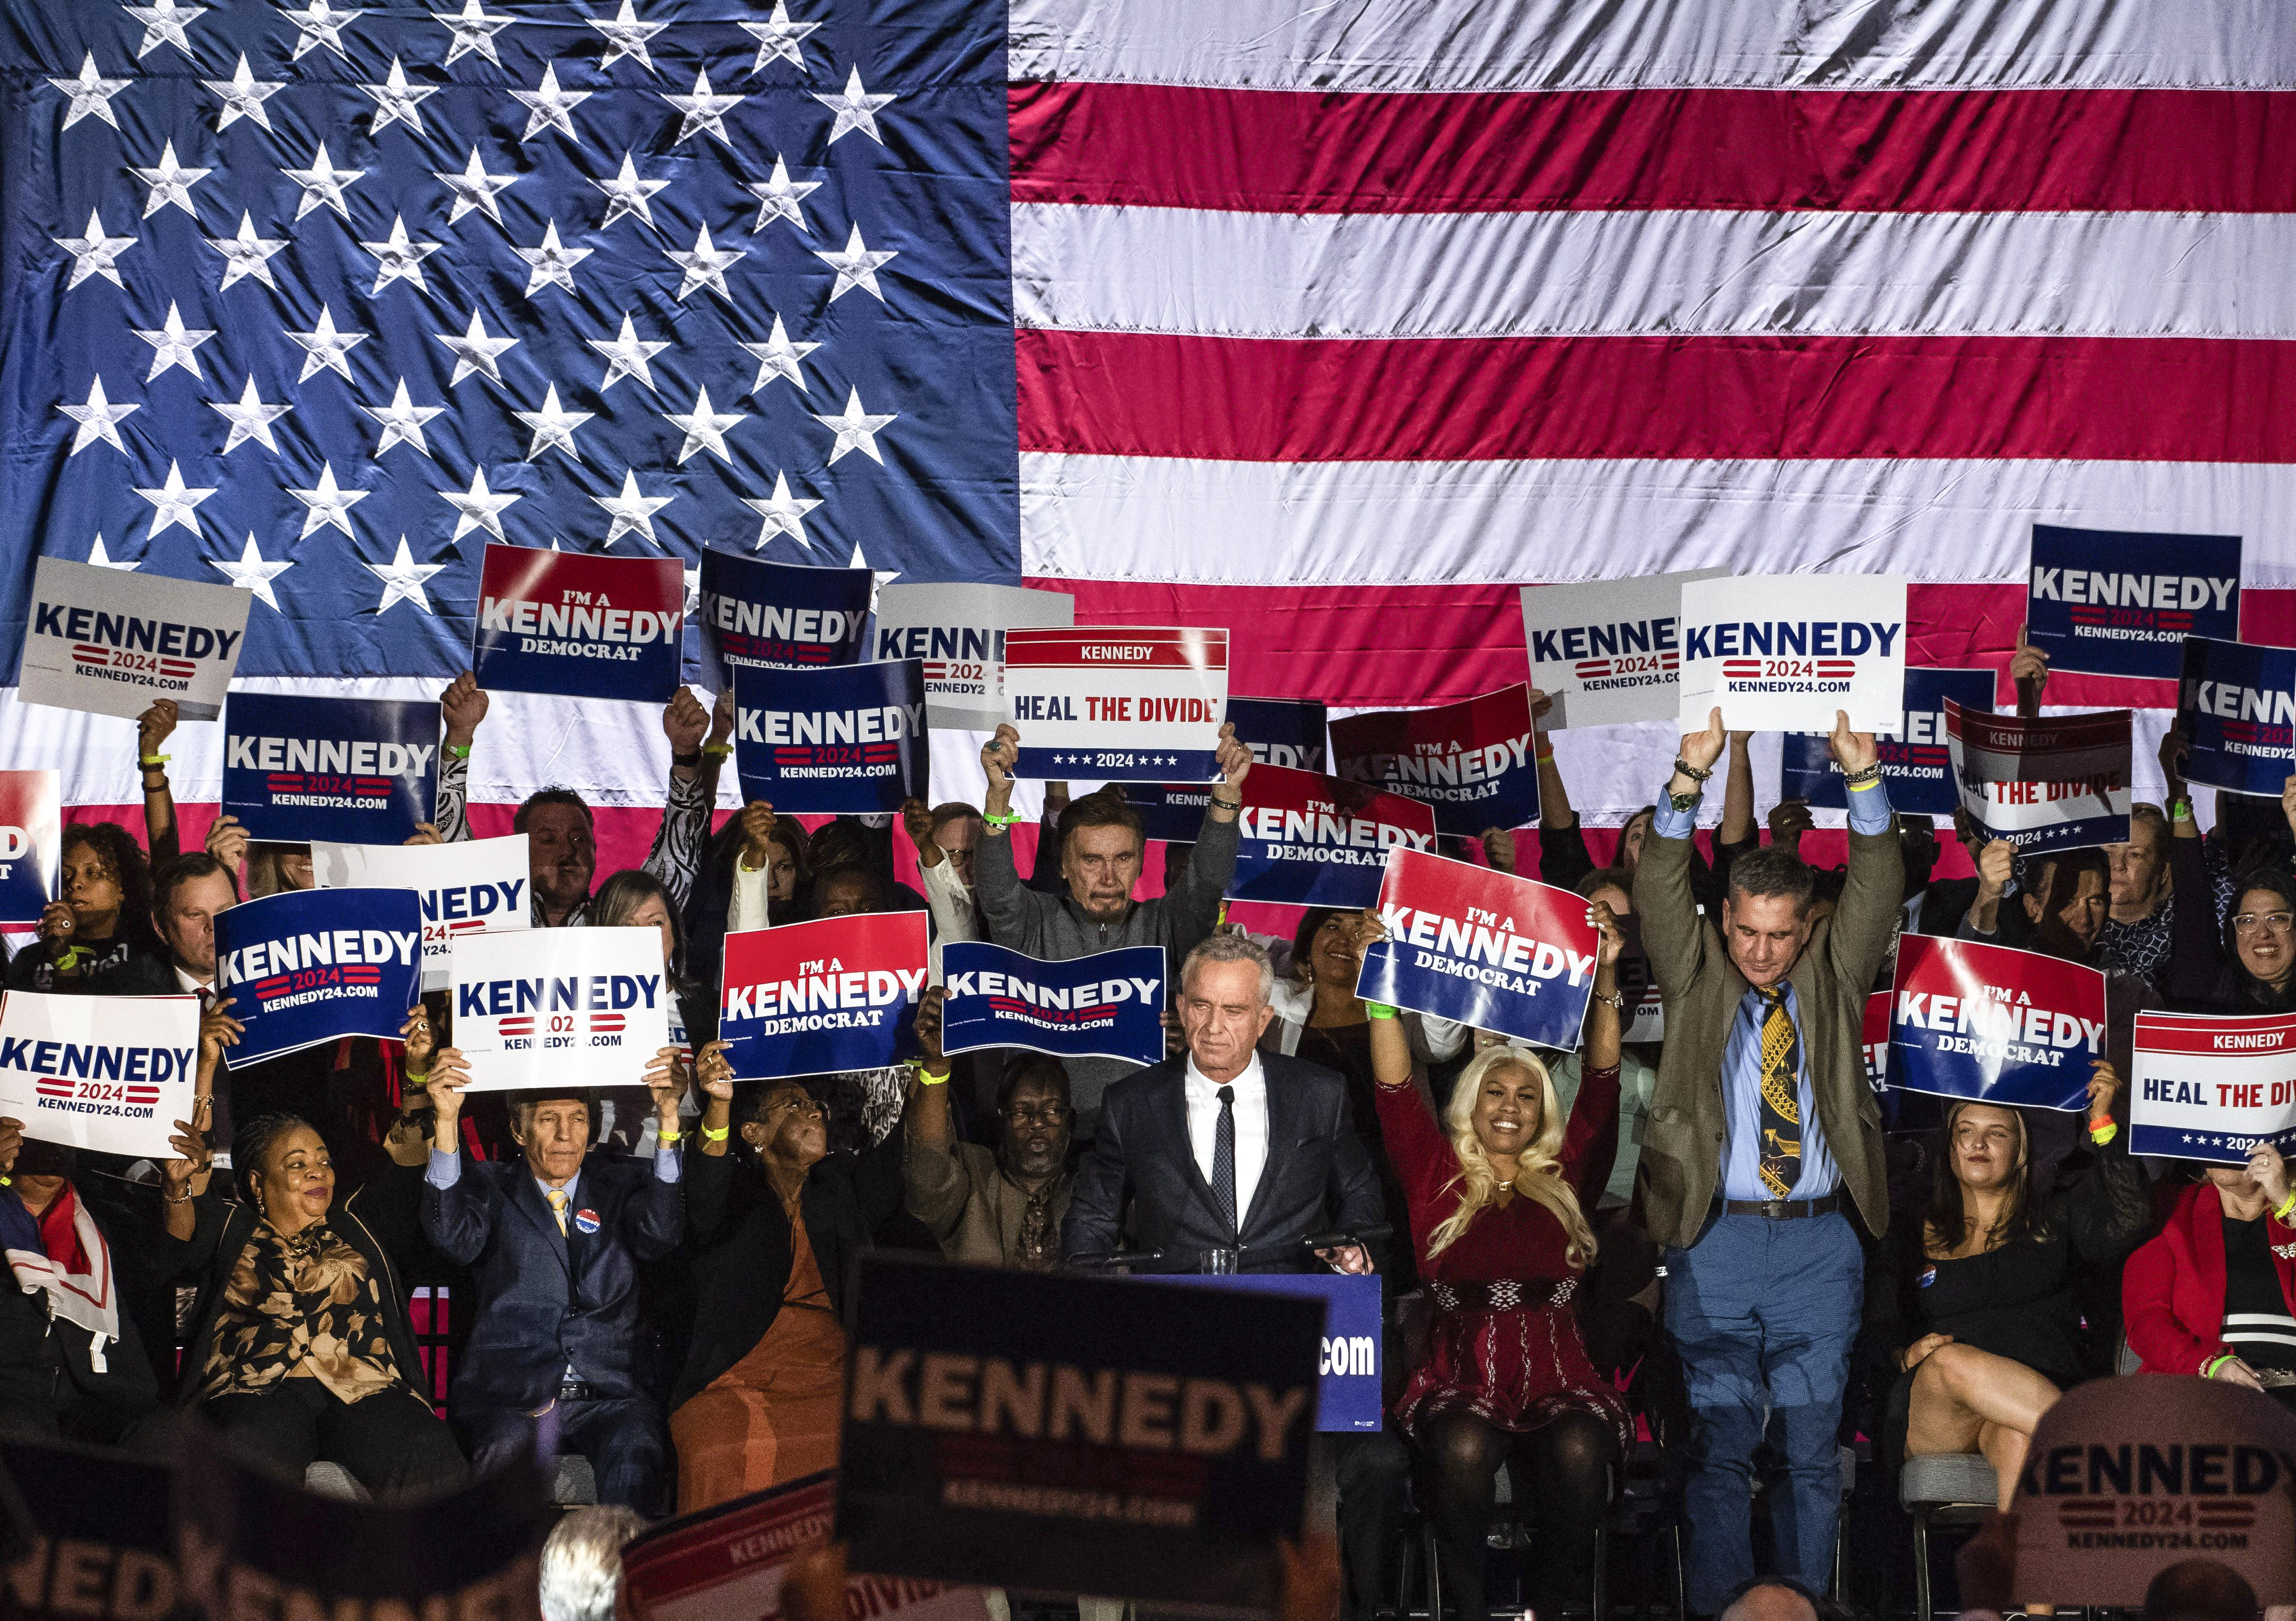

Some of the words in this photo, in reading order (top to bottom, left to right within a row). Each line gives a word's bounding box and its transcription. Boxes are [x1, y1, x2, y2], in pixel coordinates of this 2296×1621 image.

[596, 593, 610, 606] A
[2033, 567, 2236, 611] KENNEDY
[481, 597, 681, 645] KENNEDY
[701, 589, 865, 642] KENNEDY
[2111, 609, 2154, 627] 2024
[34, 602, 241, 661] KENNEDY
[1532, 616, 1681, 662] KENNE
[1686, 622, 1901, 662] KENNEDY
[2075, 626, 2188, 643] KENNEDY24.COM
[520, 638, 642, 661] DEMOCRAT
[751, 640, 793, 659] 2024
[1082, 645, 1153, 661] KENNEDY
[112, 651, 157, 673] 2024
[950, 663, 988, 680] 202
[1615, 656, 1659, 674] 2024
[1766, 661, 1813, 677] 2024
[75, 664, 189, 691] KENNEDY24.COM
[1729, 681, 1850, 693] KENNEDY24.COM
[1015, 695, 1077, 720] HEAL
[1085, 697, 1131, 722] THE
[1140, 698, 1218, 723] DIVIDE
[2184, 679, 2295, 724] KENN
[738, 702, 923, 744] KENNEDY
[1448, 740, 1462, 752] A
[1990, 731, 2057, 747] KENNEDY
[2261, 727, 2293, 744] 202
[227, 736, 435, 777] KENNEDY
[815, 747, 862, 764] 2024
[1096, 754, 1134, 767] 2024
[1341, 733, 1530, 786] KENNEDY
[1877, 745, 1909, 762] 024
[780, 764, 896, 778] KENNEDY24.COM
[308, 776, 352, 793] 2024
[1387, 780, 1499, 801] DEMOCRAT
[1956, 764, 1988, 801] HEAL
[1994, 781, 2038, 805] THE
[2046, 771, 2121, 802] DIVIDE
[272, 795, 387, 810] KENNEDY24.COM
[1239, 806, 1433, 852] KENNEDY
[2006, 831, 2041, 846] 2024
[1468, 907, 1496, 926] I'M
[1499, 917, 1515, 932] A
[1381, 902, 1595, 988] KENNEDY
[219, 930, 419, 989] KENNEDY
[799, 960, 824, 976] I'M
[828, 957, 844, 972] A
[294, 967, 340, 990] 2024
[1414, 952, 1541, 997] DEMOCRAT
[263, 986, 378, 1013] KENNEDY24.COM
[460, 975, 660, 1017] KENNEDY
[727, 968, 927, 1022] KENNEDY
[948, 971, 1161, 1009] KENNEDY
[1983, 985, 2012, 1003] I'M
[2016, 990, 2032, 1005] A
[764, 1009, 883, 1036] DEMOCRAT
[994, 1010, 1113, 1031] KENNEDY24.COM
[1031, 1005, 1076, 1021] 2024
[1897, 990, 2105, 1055] KENNEDY
[1937, 1035, 2064, 1067] DEMOCRAT
[2214, 1032, 2285, 1048] KENNEDY
[0, 1037, 194, 1082] KENNEDY
[77, 1082, 123, 1101] 2024
[2144, 1079, 2207, 1106] HEAL
[2216, 1084, 2263, 1108] THE
[38, 1098, 154, 1119] KENNEDY24.COM
[576, 1214, 600, 1227] Kennedy
[576, 1222, 597, 1233] DEMOCRAT
[848, 1346, 1308, 1461] KENNEDY
[2122, 1501, 2194, 1527] 2024
[2067, 1532, 2248, 1550] KENNEDY24.COM
